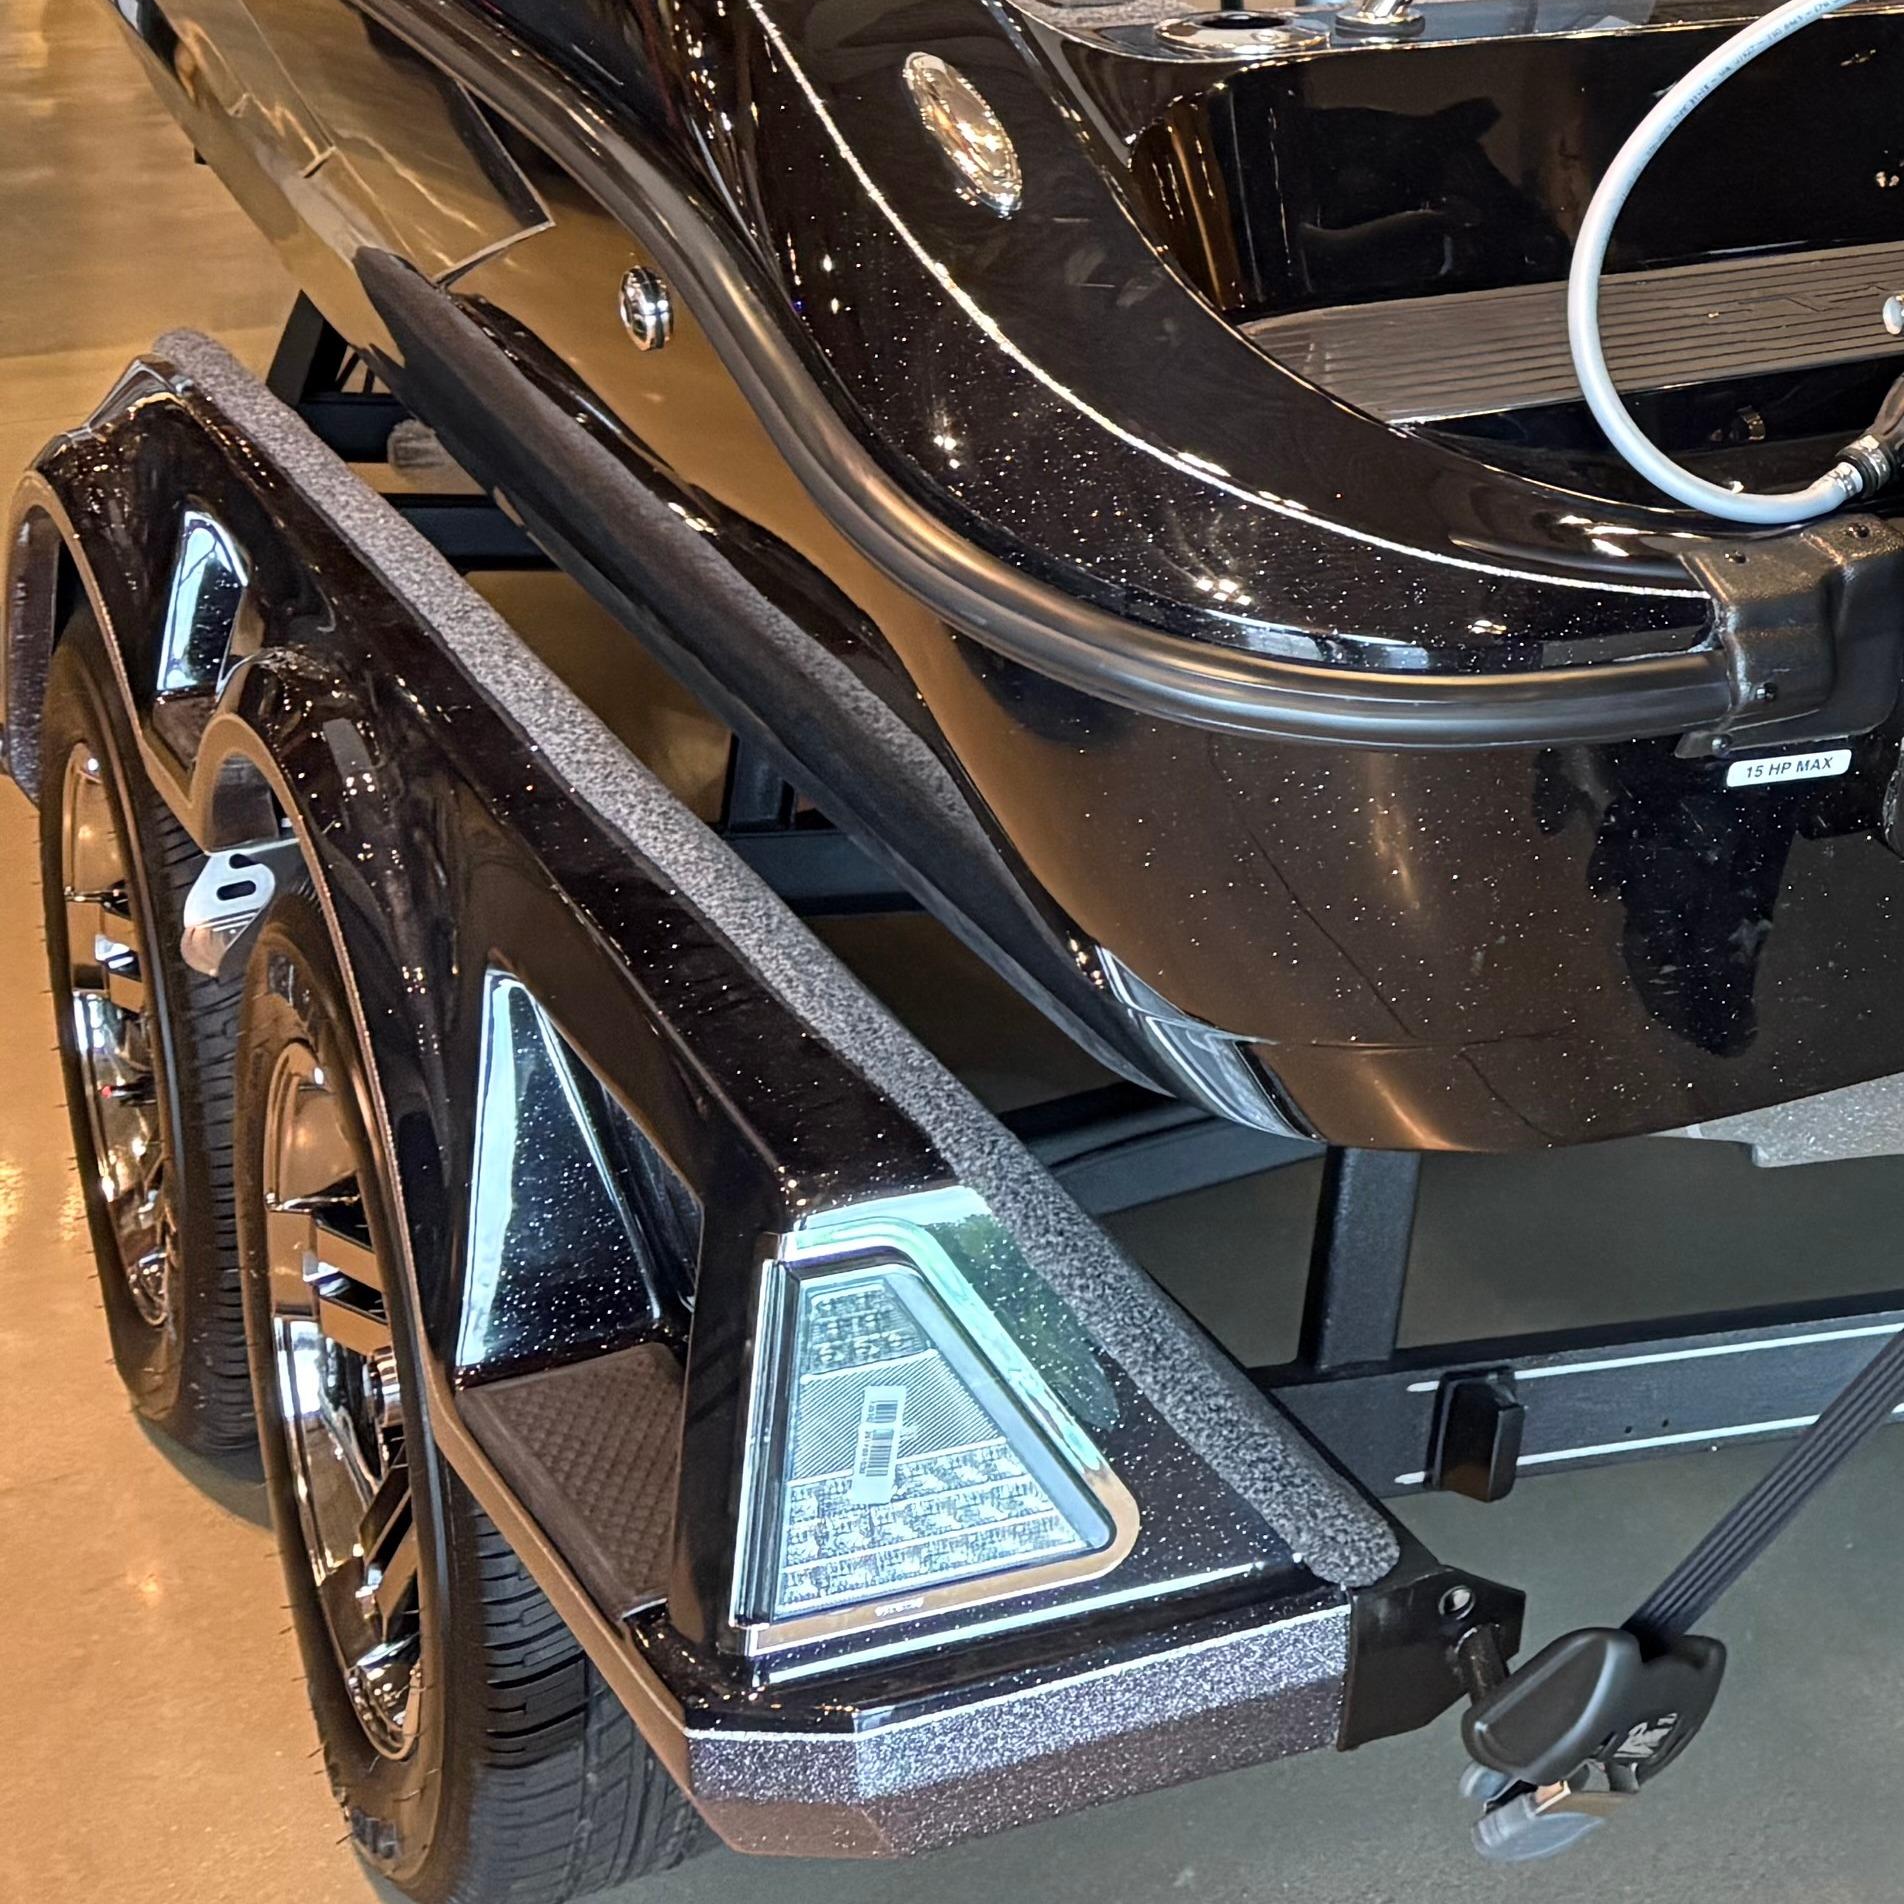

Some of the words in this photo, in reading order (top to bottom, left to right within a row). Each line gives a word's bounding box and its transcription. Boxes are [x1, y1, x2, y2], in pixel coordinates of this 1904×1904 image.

[1746, 765, 1765, 778] 15
[1768, 761, 1792, 776] HP
[1796, 756, 1834, 773] MAX
